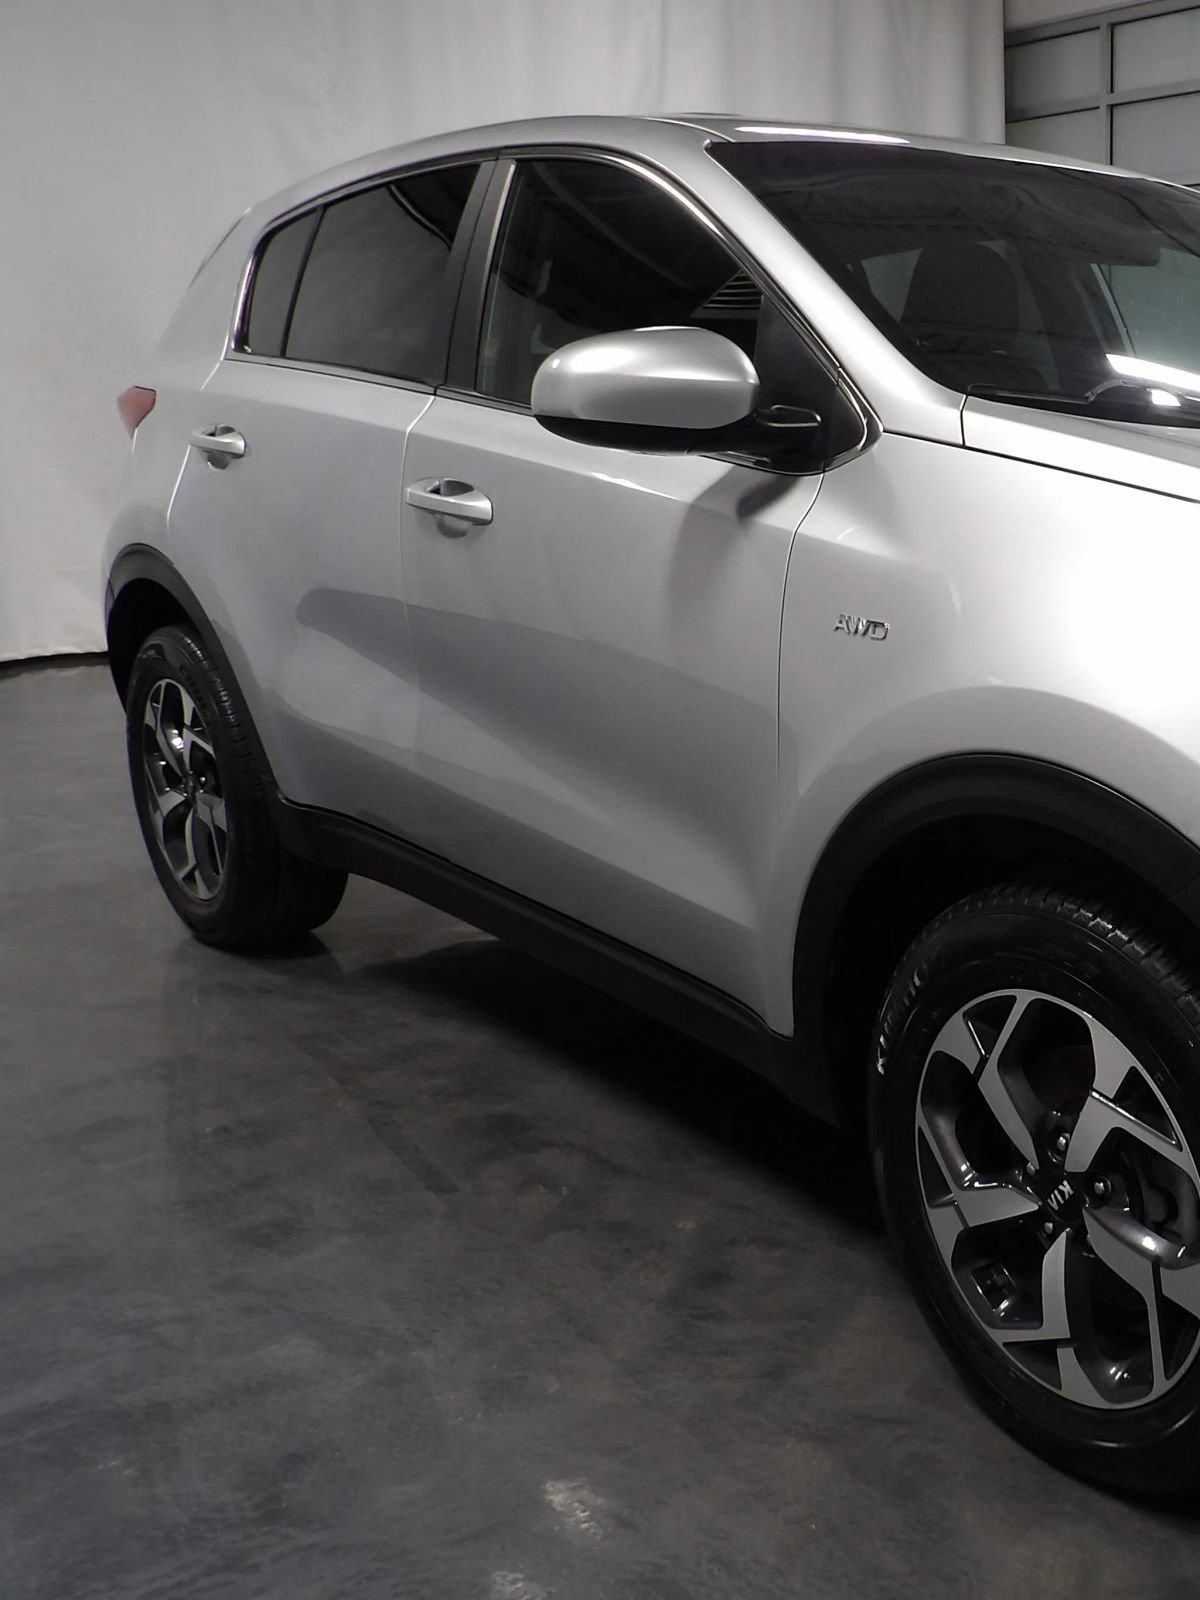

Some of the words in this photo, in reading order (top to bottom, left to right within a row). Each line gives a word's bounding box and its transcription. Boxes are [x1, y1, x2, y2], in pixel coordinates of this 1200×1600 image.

[833, 614, 890, 641] AWD
[877, 961, 928, 1076] KUHO
[1047, 1180, 1074, 1210] KIA
